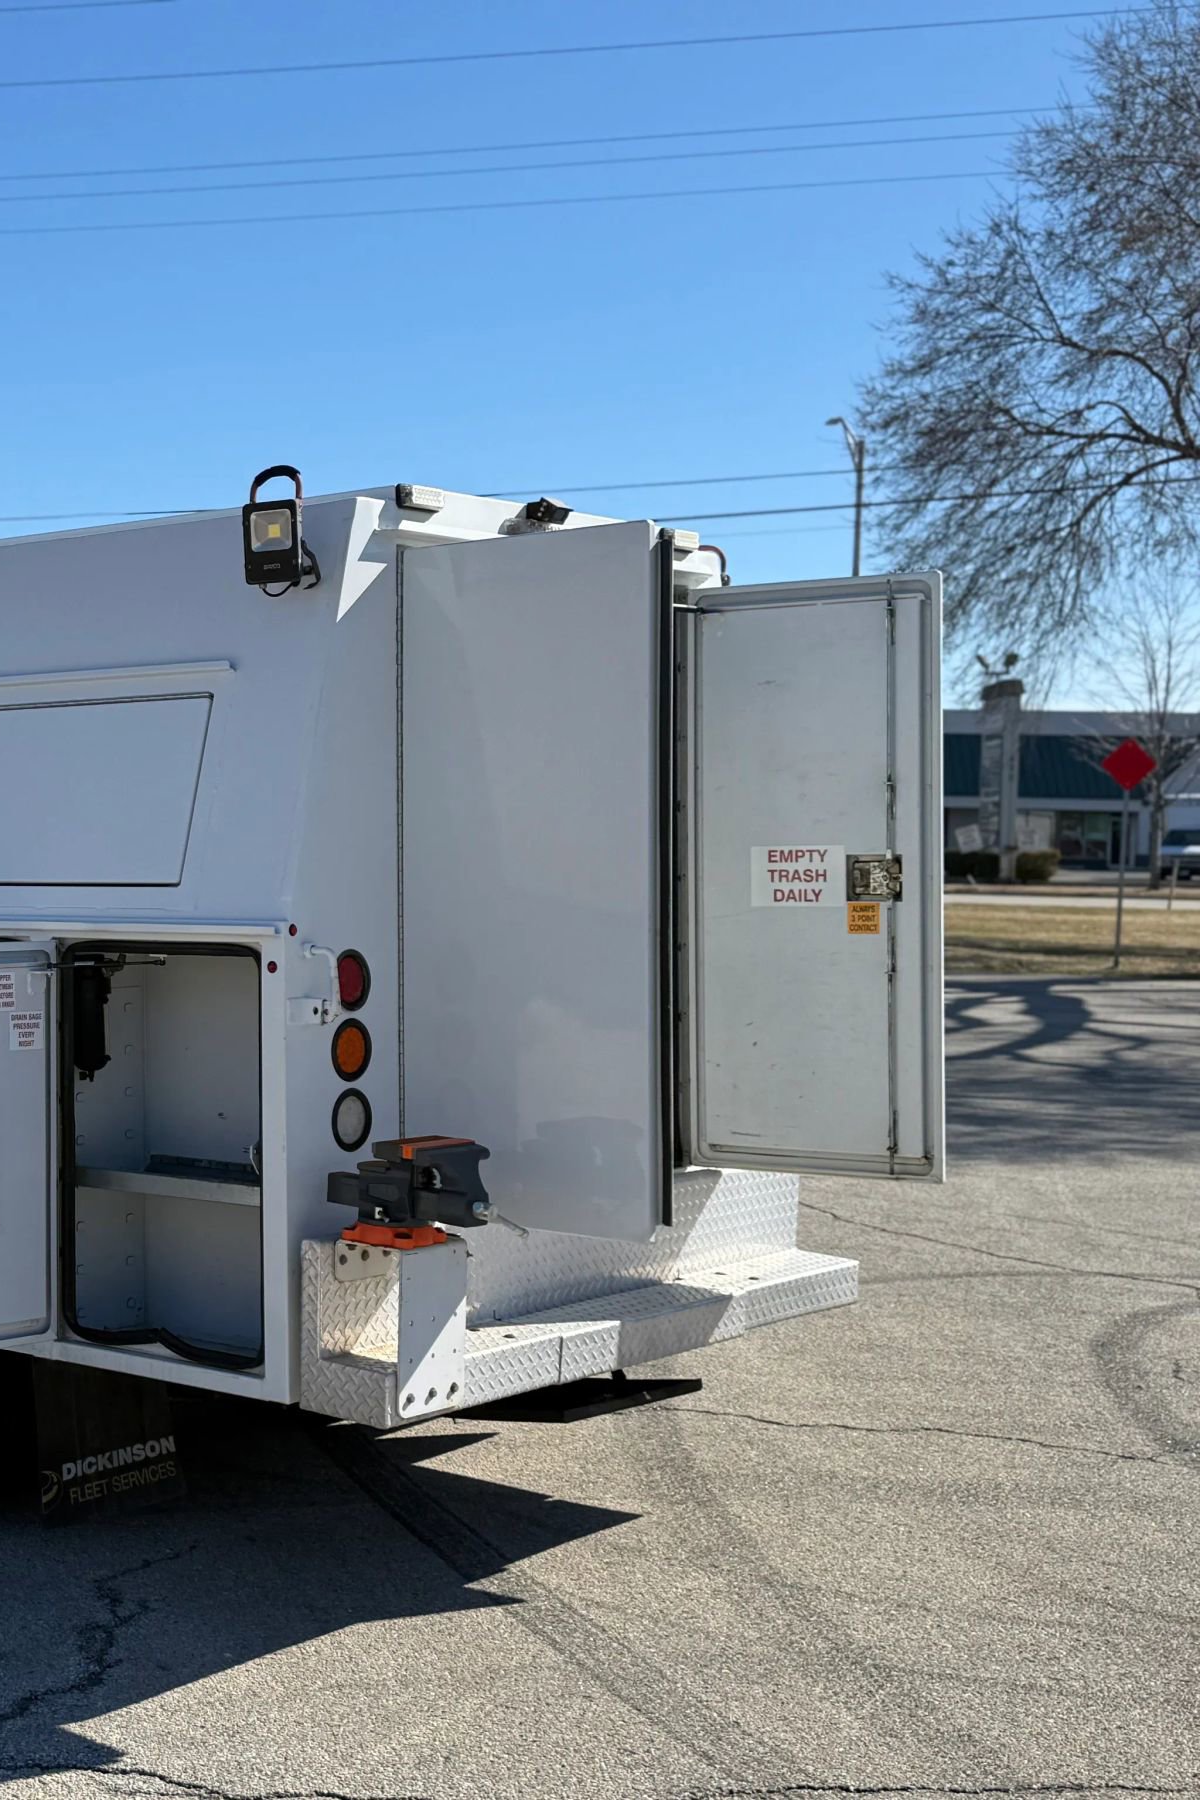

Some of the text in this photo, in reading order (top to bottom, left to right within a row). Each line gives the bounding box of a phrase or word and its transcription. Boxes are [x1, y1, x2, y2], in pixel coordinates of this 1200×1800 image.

[767, 849, 828, 863] EMPTY
[767, 869, 827, 883] TRASH
[773, 889, 823, 902] DAILY
[851, 905, 875, 913] ALWAYS
[851, 914, 875, 922] 3 POINT
[849, 923, 878, 932] CONTACT
[11, 1013, 28, 1021] DRAIN
[13, 1022, 41, 1030] PRESSURE
[18, 1031, 35, 1039] EVERY
[62, 1435, 176, 1481] DICKINSON
[69, 1461, 177, 1505] FLEET SERVICES
